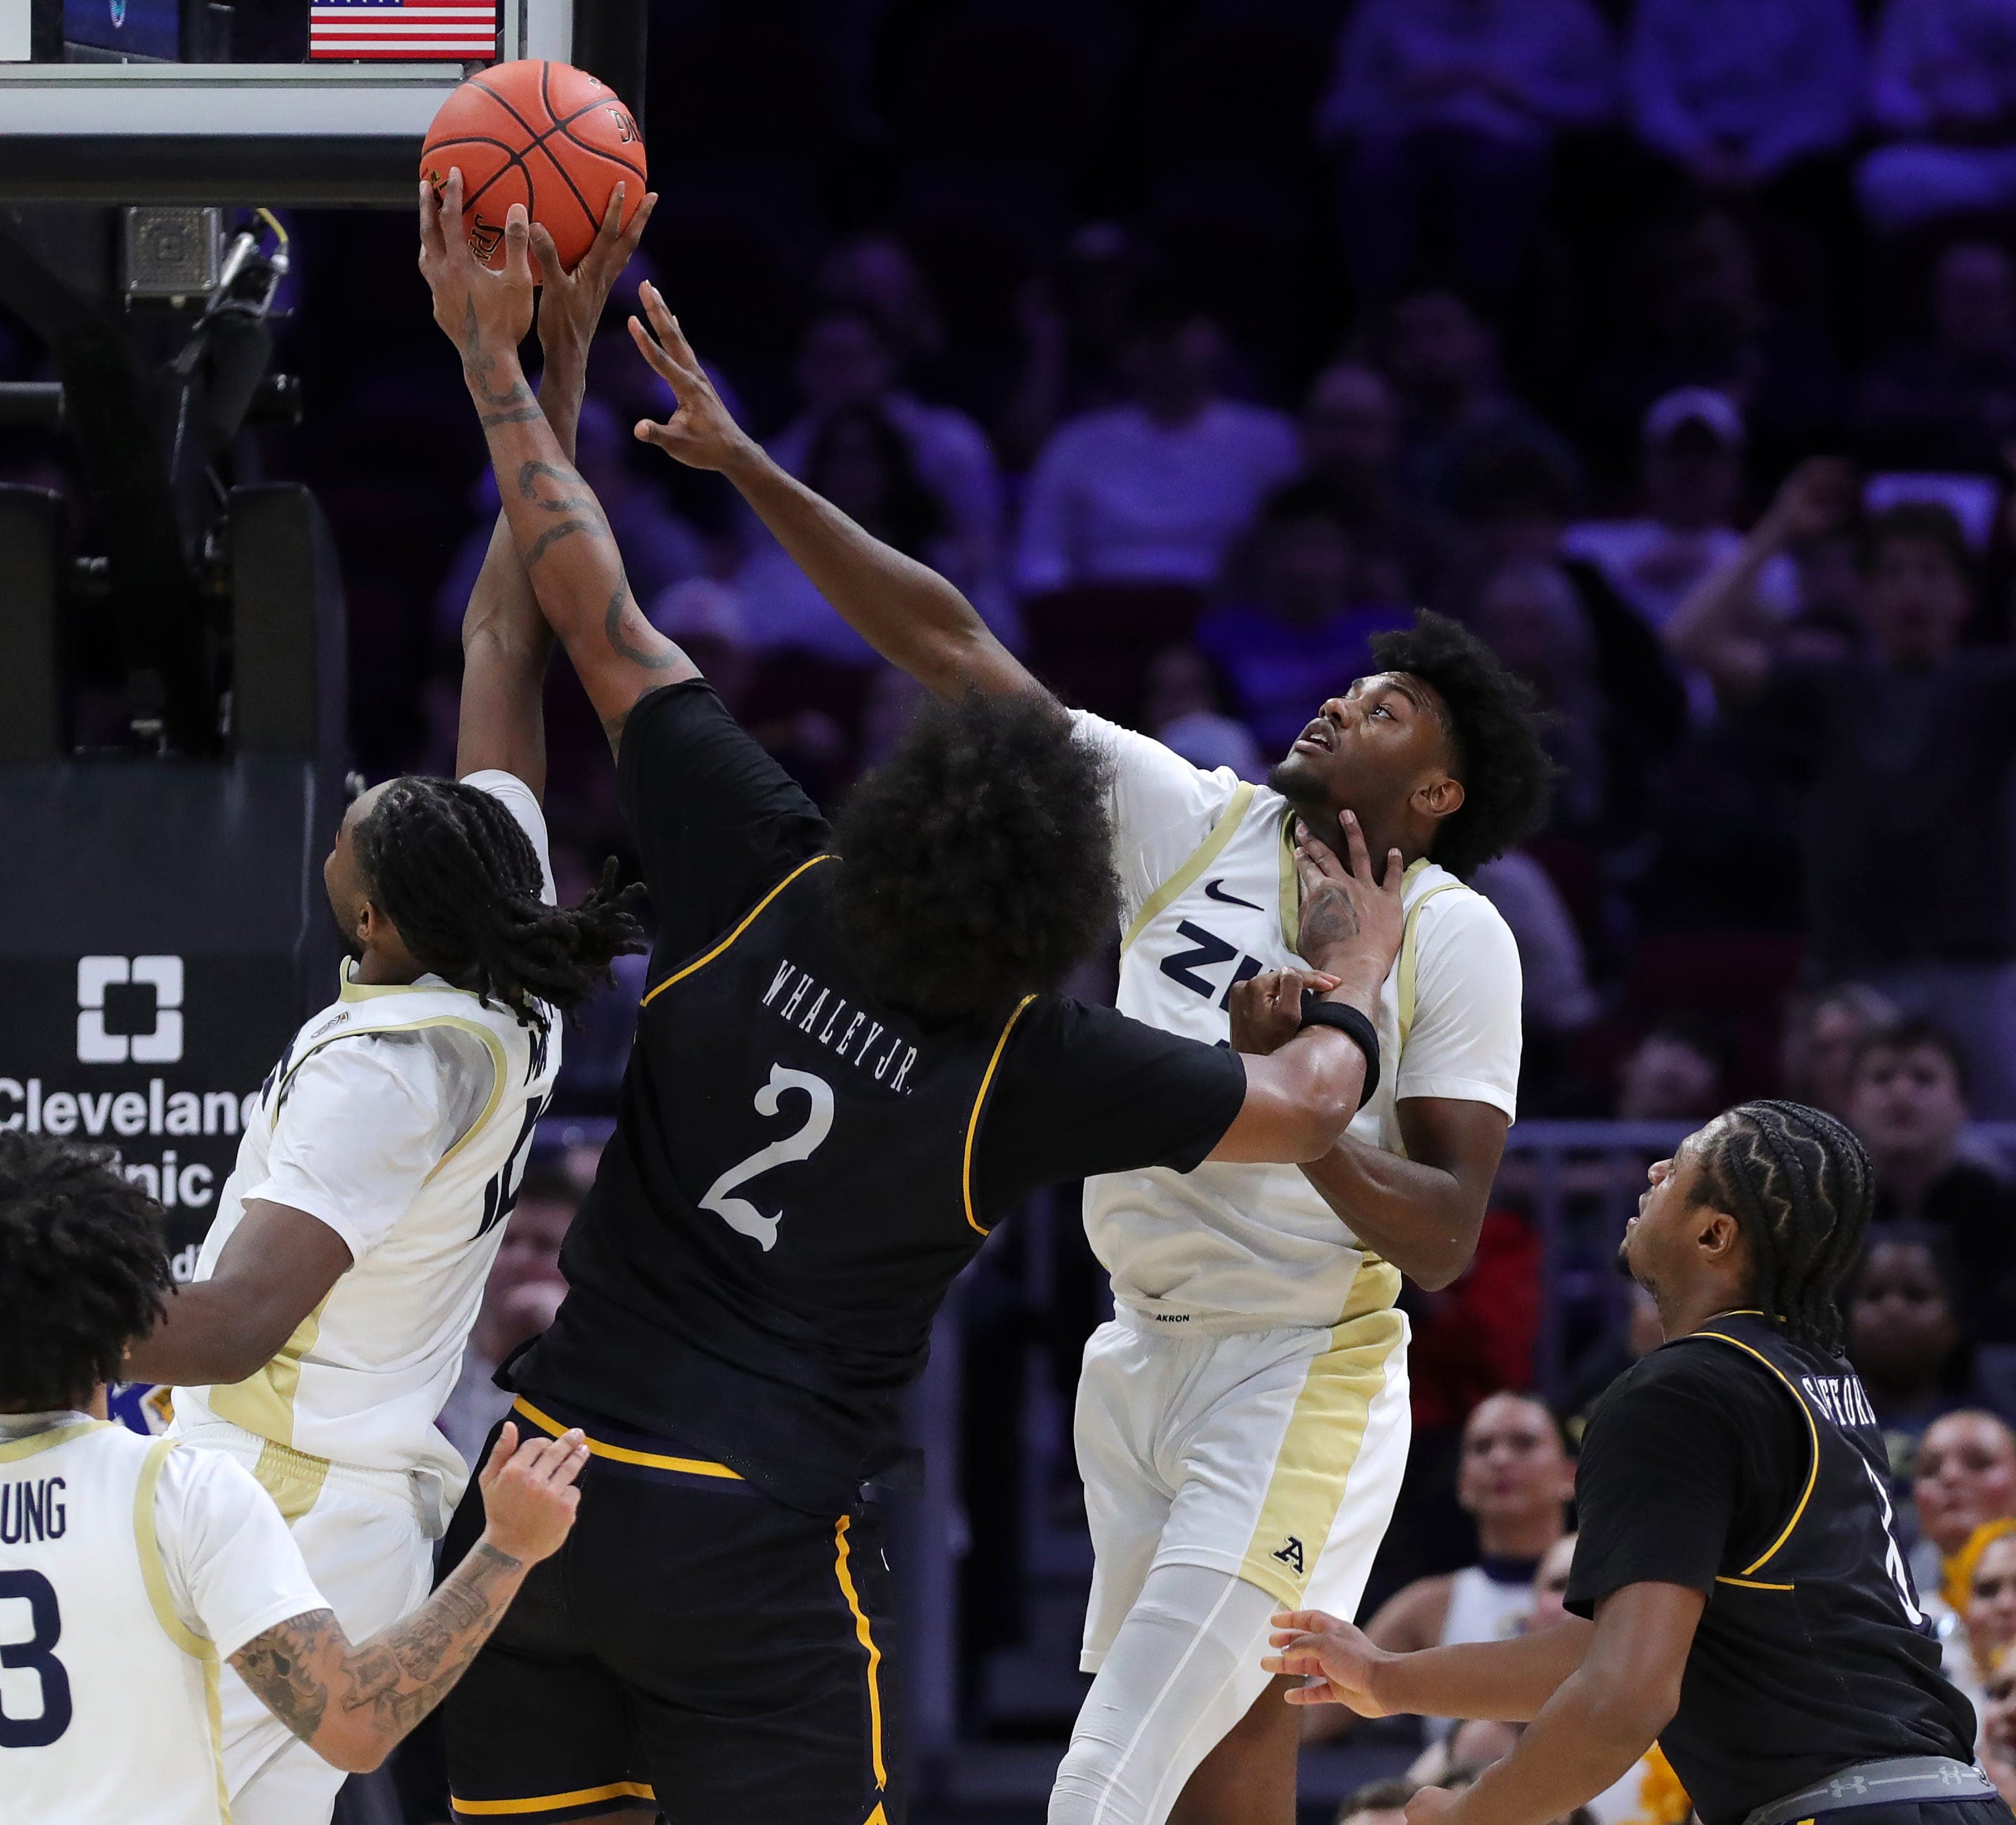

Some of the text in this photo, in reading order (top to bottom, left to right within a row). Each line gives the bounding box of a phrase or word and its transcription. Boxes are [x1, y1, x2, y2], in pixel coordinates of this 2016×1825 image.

[761, 958, 884, 1067] WHALEY
[114, 1149, 215, 1209] nic
[697, 1061, 835, 1252] 2
[1155, 1313, 1190, 1323] AKRON
[0, 1476, 67, 1545] UNG
[0, 1569, 73, 1749] 3
